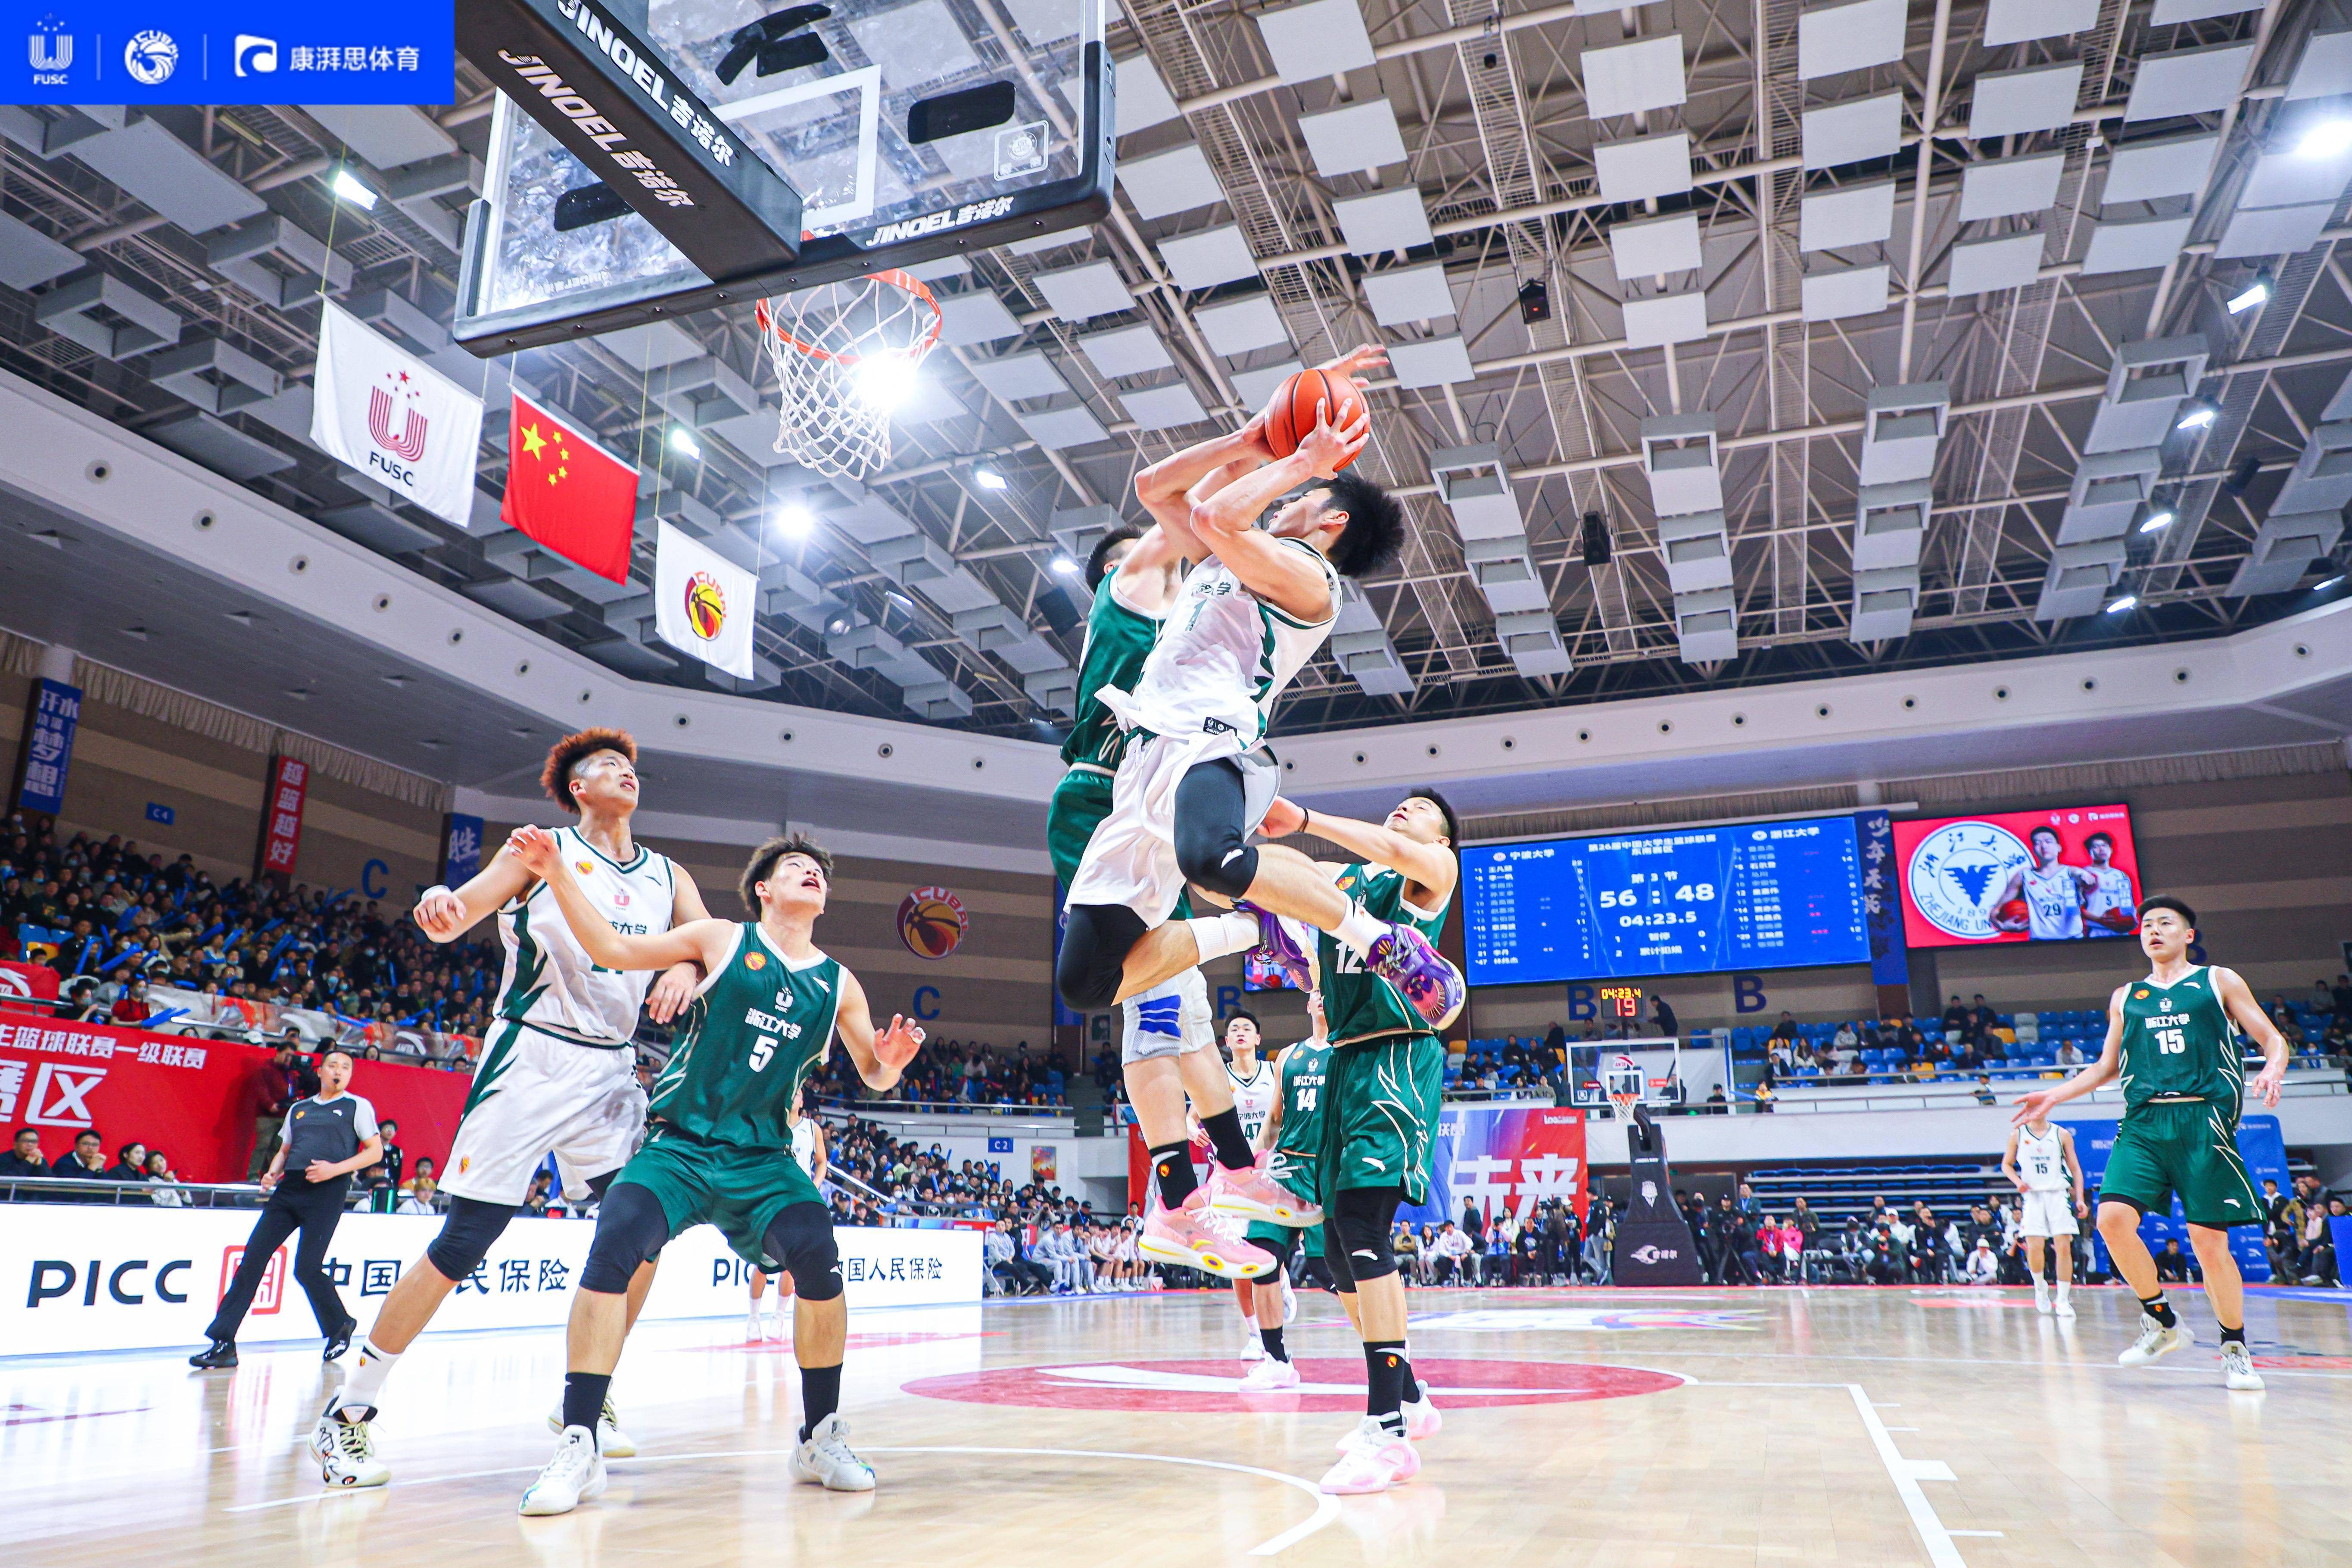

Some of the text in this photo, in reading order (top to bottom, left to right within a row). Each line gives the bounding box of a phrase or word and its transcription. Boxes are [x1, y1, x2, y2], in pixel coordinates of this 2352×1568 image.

[498, 49, 627, 151] JINOEL
[866, 209, 956, 246] JINOEL
[369, 450, 414, 487] FUSC
[362, 858, 388, 899] C
[1600, 889, 1638, 909] 56
[1675, 883, 1716, 902] 48
[1920, 892, 1969, 931] ZHEJIANG
[2043, 903, 2061, 916] 29
[1619, 910, 1697, 927] 04:23.5
[1336, 940, 1362, 974] 12
[913, 986, 941, 1020] C
[1567, 984, 1598, 1020] B
[1600, 987, 1642, 1000] 04:23.4
[1615, 998, 1637, 1017] 19
[1733, 975, 1767, 1013] B
[744, 1007, 802, 1040] 浙江大学
[2144, 1013, 2190, 1029] 浙江大学
[748, 1034, 779, 1073] 5
[2154, 1029, 2186, 1055] 15
[1296, 1088, 1316, 1112] 14
[1245, 1122, 1262, 1140] 47
[2035, 1163, 2048, 1175] 15
[26, 1257, 570, 1308] PICC 中国民保险
[838, 1257, 943, 1282] 国人民保险
